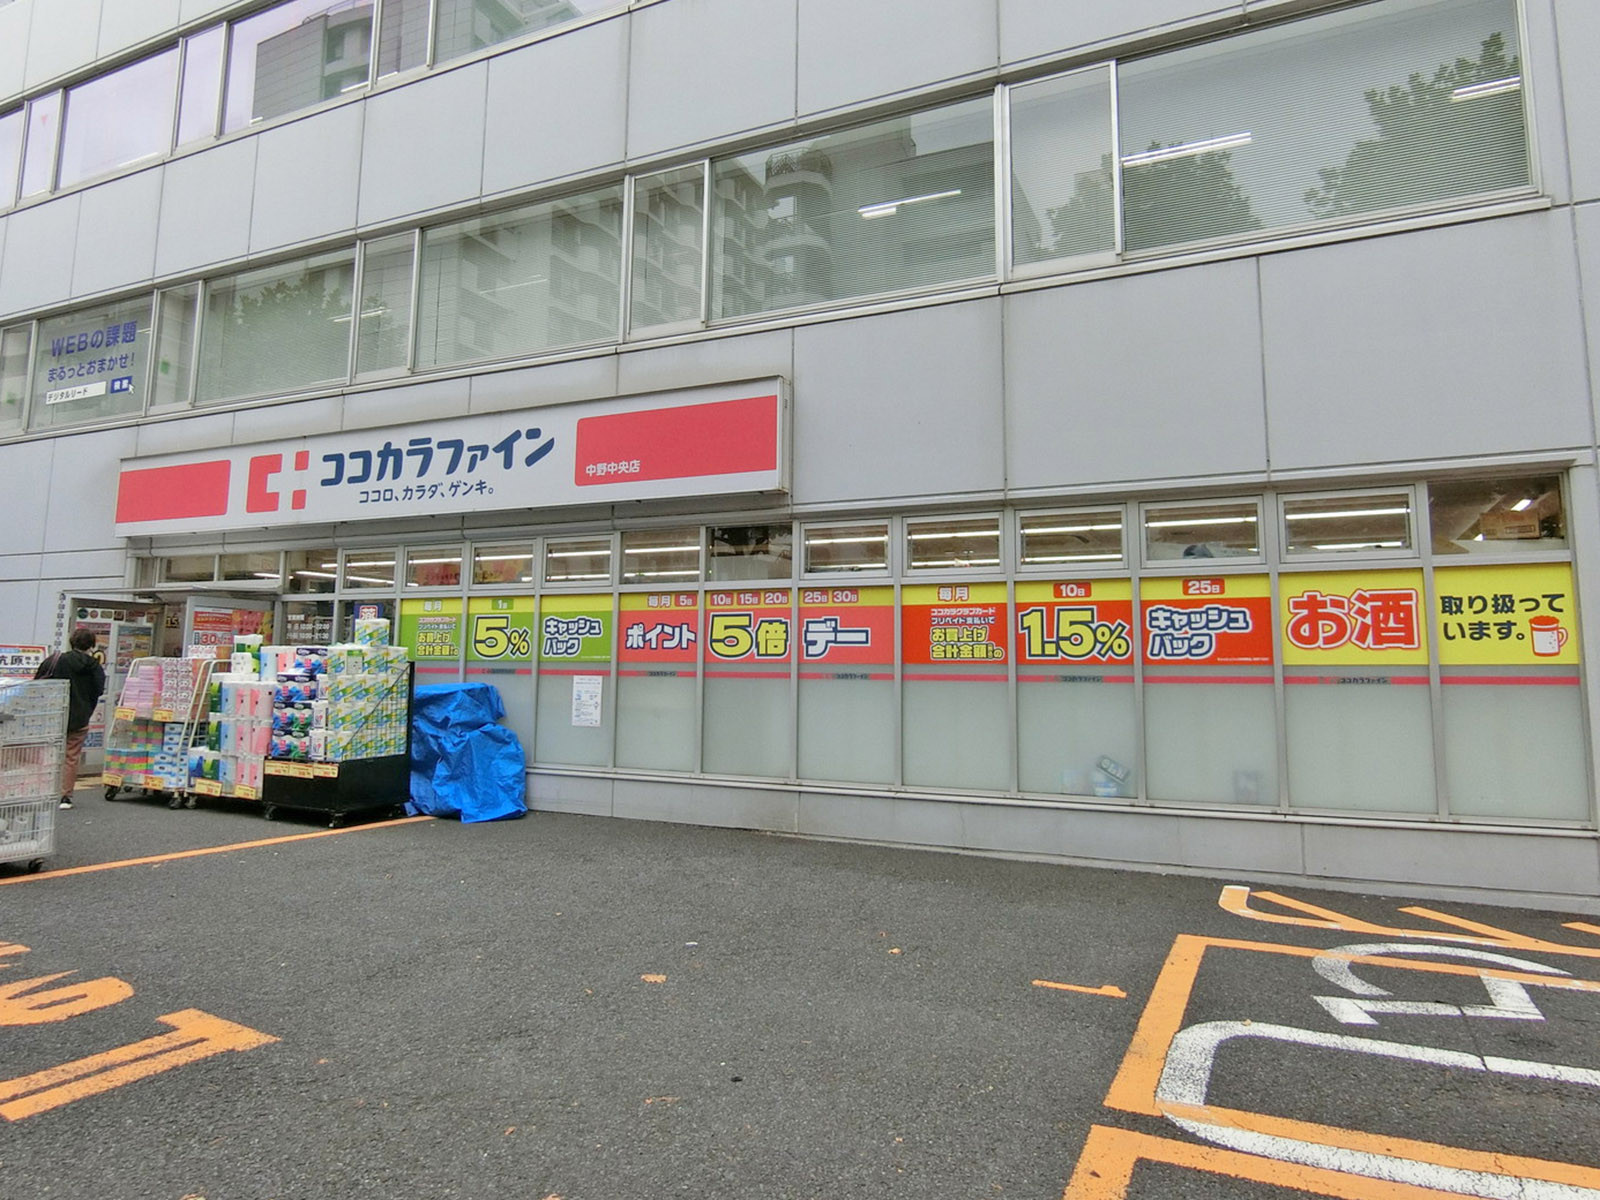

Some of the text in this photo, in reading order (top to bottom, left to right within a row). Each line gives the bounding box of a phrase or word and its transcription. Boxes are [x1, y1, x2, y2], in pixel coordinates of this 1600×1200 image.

[51, 321, 138, 357] WEBの課題
[320, 427, 555, 486] ココカラファイン
[585, 459, 641, 477] 中野中央店
[359, 480, 494, 504] ココロ、カラダ、ゲンキ。
[938, 586, 969, 602] 毎月
[1060, 584, 1086, 597] 10日
[1188, 580, 1221, 594] 25日
[648, 591, 858, 608] 毎月 5日 10日 15日 20日 25日 30日
[931, 607, 996, 615] ココカラクラブカード
[1440, 593, 1565, 616] 取り扱って
[544, 617, 603, 636] キャッシュ
[1147, 605, 1252, 631] キャッシュ
[1287, 589, 1420, 649] お酒
[473, 615, 531, 659] 5%
[625, 623, 697, 649] ポイント
[709, 612, 790, 659] 5倍
[803, 617, 871, 660] デー
[931, 627, 987, 642] お買上げ
[1020, 607, 1130, 659] 1.5%
[1443, 620, 1526, 641] います。
[543, 635, 582, 657] バック
[1148, 631, 1214, 657] バック
